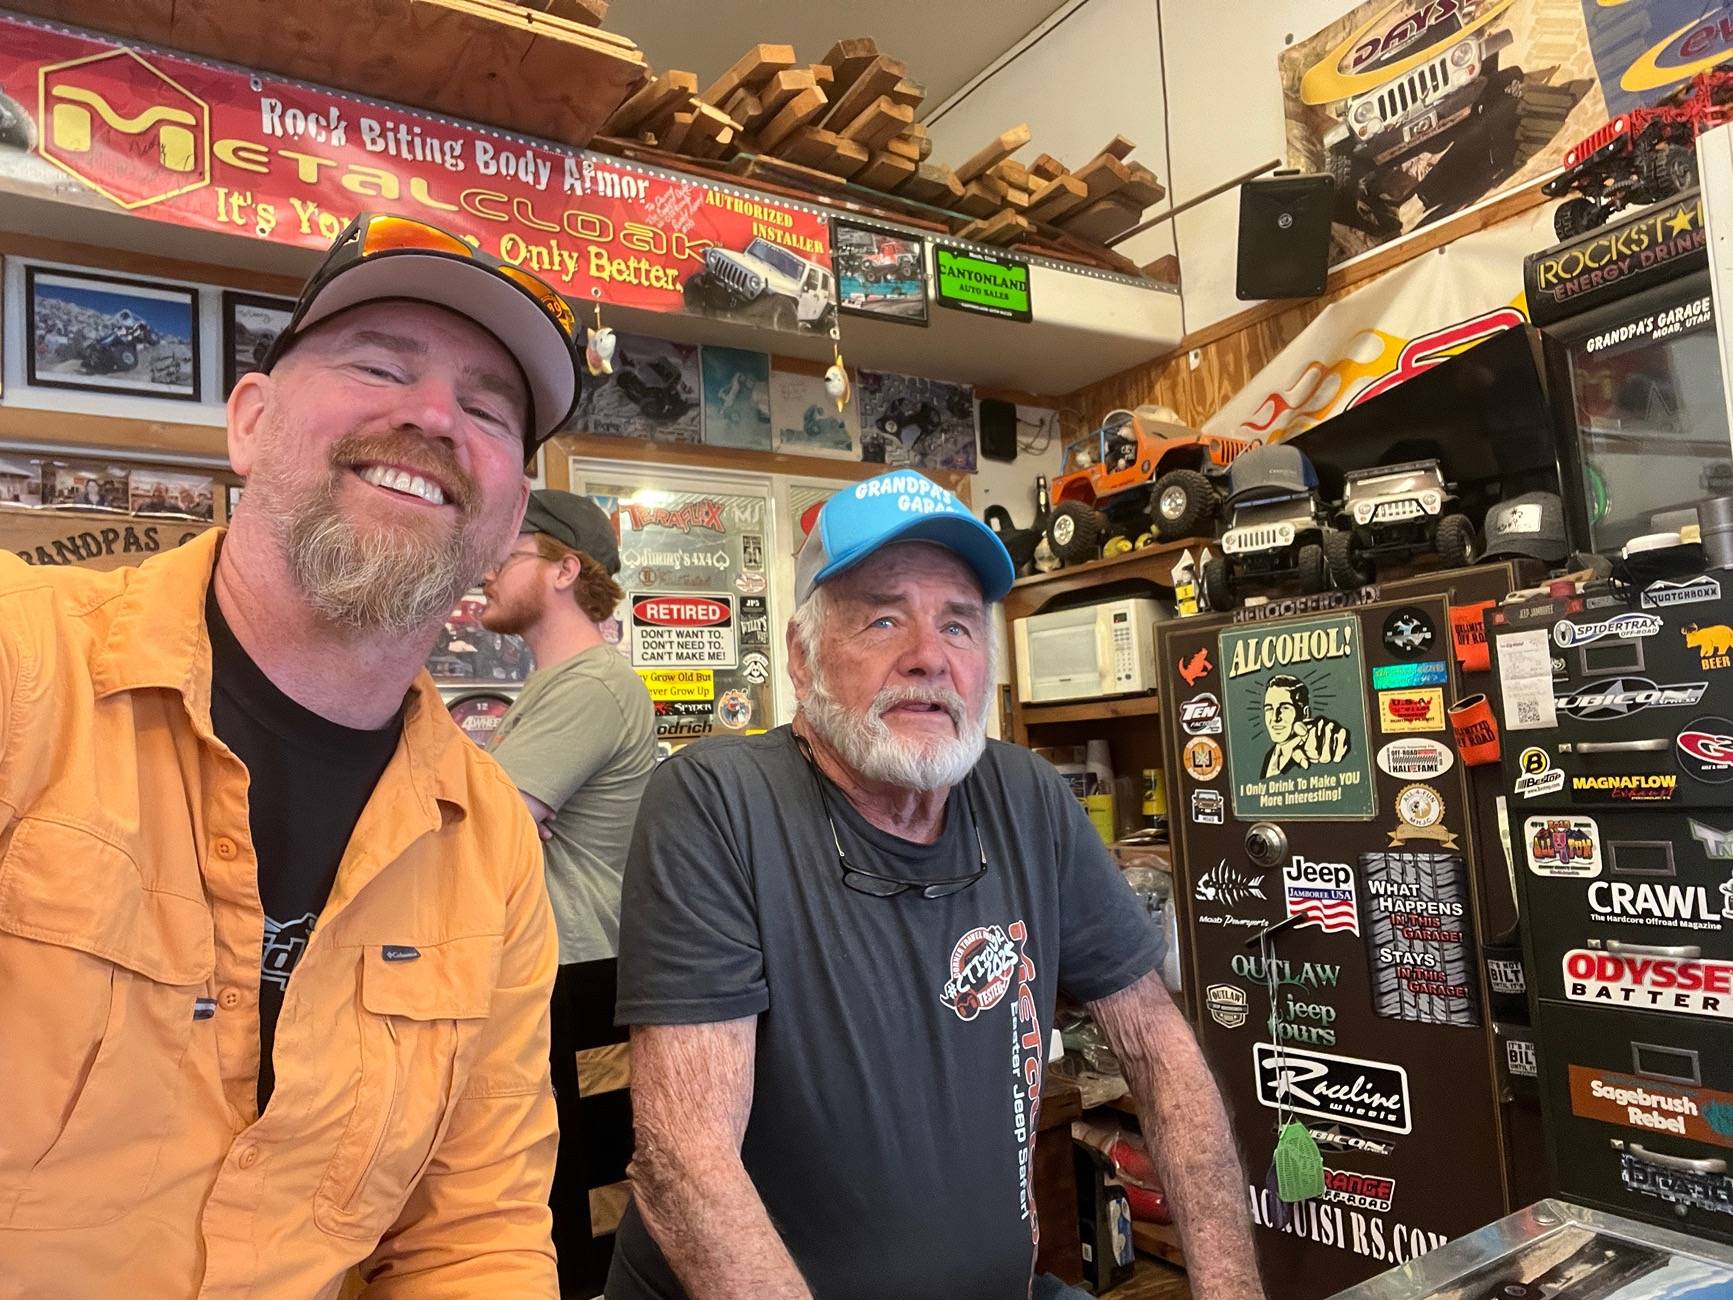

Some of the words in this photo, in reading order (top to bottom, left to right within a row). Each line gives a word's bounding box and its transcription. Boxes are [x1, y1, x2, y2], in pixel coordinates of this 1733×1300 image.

[261, 97, 347, 147] Rock
[360, 117, 465, 172] Biting
[475, 140, 551, 191] Body
[563, 158, 650, 200] Armor
[705, 190, 794, 228] AUTHORIZED
[215, 187, 277, 231] It's
[500, 233, 580, 283] Only
[587, 245, 683, 293] Better.
[752, 222, 825, 255] INSTALLER
[1555, 257, 1632, 299] ENERGY
[1640, 230, 1706, 267] DRINK
[959, 283, 981, 296] AUTO
[984, 288, 1009, 300] SALES
[1587, 315, 1654, 352] GRANDPA'S
[1657, 297, 1710, 328] GARAGE
[1653, 323, 1683, 340] MOAB,
[1686, 311, 1711, 328] UTAH
[646, 603, 721, 620] RETIRED
[641, 629, 673, 639] DON'T
[675, 629, 705, 639] WANT
[707, 630, 724, 639] TO.
[1577, 618, 1659, 637] SPIDERTRAX
[642, 641, 674, 650] DON'T
[677, 641, 705, 650] NEED
[707, 641, 724, 650] TO.
[1229, 626, 1352, 678] ALCOHOL!
[641, 651, 673, 661] CAN'T
[675, 652, 705, 661] MAKE
[708, 652, 726, 661] ME!
[1701, 655, 1730, 672] BEER
[650, 672, 675, 682] Grow
[678, 672, 694, 682] Old
[696, 672, 711, 682] But
[670, 687, 694, 696] Grow
[697, 687, 710, 698] Up
[1182, 702, 1216, 721] TEN
[1525, 752, 1543, 773] B
[1240, 785, 1245, 796] I
[1246, 782, 1267, 797] Only
[1269, 779, 1295, 794] Drink
[1296, 777, 1308, 790] To
[1310, 775, 1336, 789] Make
[1339, 771, 1360, 785] YOU
[1572, 775, 1677, 790] MAGNAFLOW
[1260, 794, 1283, 808] More
[1285, 787, 1342, 805] Interesting!
[1287, 856, 1351, 888] Jeep
[1289, 887, 1329, 899] JAMBOREE
[1331, 890, 1351, 900] USA
[1368, 880, 1419, 896] WHAT
[1380, 897, 1463, 915] HAPPENS
[1587, 881, 1720, 921] CRAWL
[1199, 915, 1222, 924] Moab
[1391, 913, 1405, 925] IN
[1408, 914, 1440, 927] THIS
[1591, 913, 1605, 922] The
[1607, 914, 1644, 925] Hardcore
[1646, 917, 1678, 928] Offroad
[1679, 921, 1722, 931] Magazine
[1403, 927, 1463, 942] GARAGE!
[1380, 948, 1435, 967] STAYS
[1231, 954, 1341, 989] OUTLAW
[1396, 966, 1411, 978] IN
[1413, 967, 1447, 982] THIS
[1490, 968, 1521, 983] BILT
[1567, 953, 1733, 996] ODYSSE
[1212, 989, 1241, 1002] OUTLAW
[1408, 981, 1468, 997] GARAGE!
[1286, 994, 1336, 1027] jeep
[1509, 1049, 1535, 1065] BIL
[1261, 1057, 1401, 1110] Raceline
[1590, 1080, 1698, 1116] Sagebrush
[1013, 1084, 1026, 1143] Jeep
[1329, 1102, 1397, 1121] wheels
[1627, 1106, 1686, 1134] Rebel
[1018, 1147, 1029, 1220] Safari
